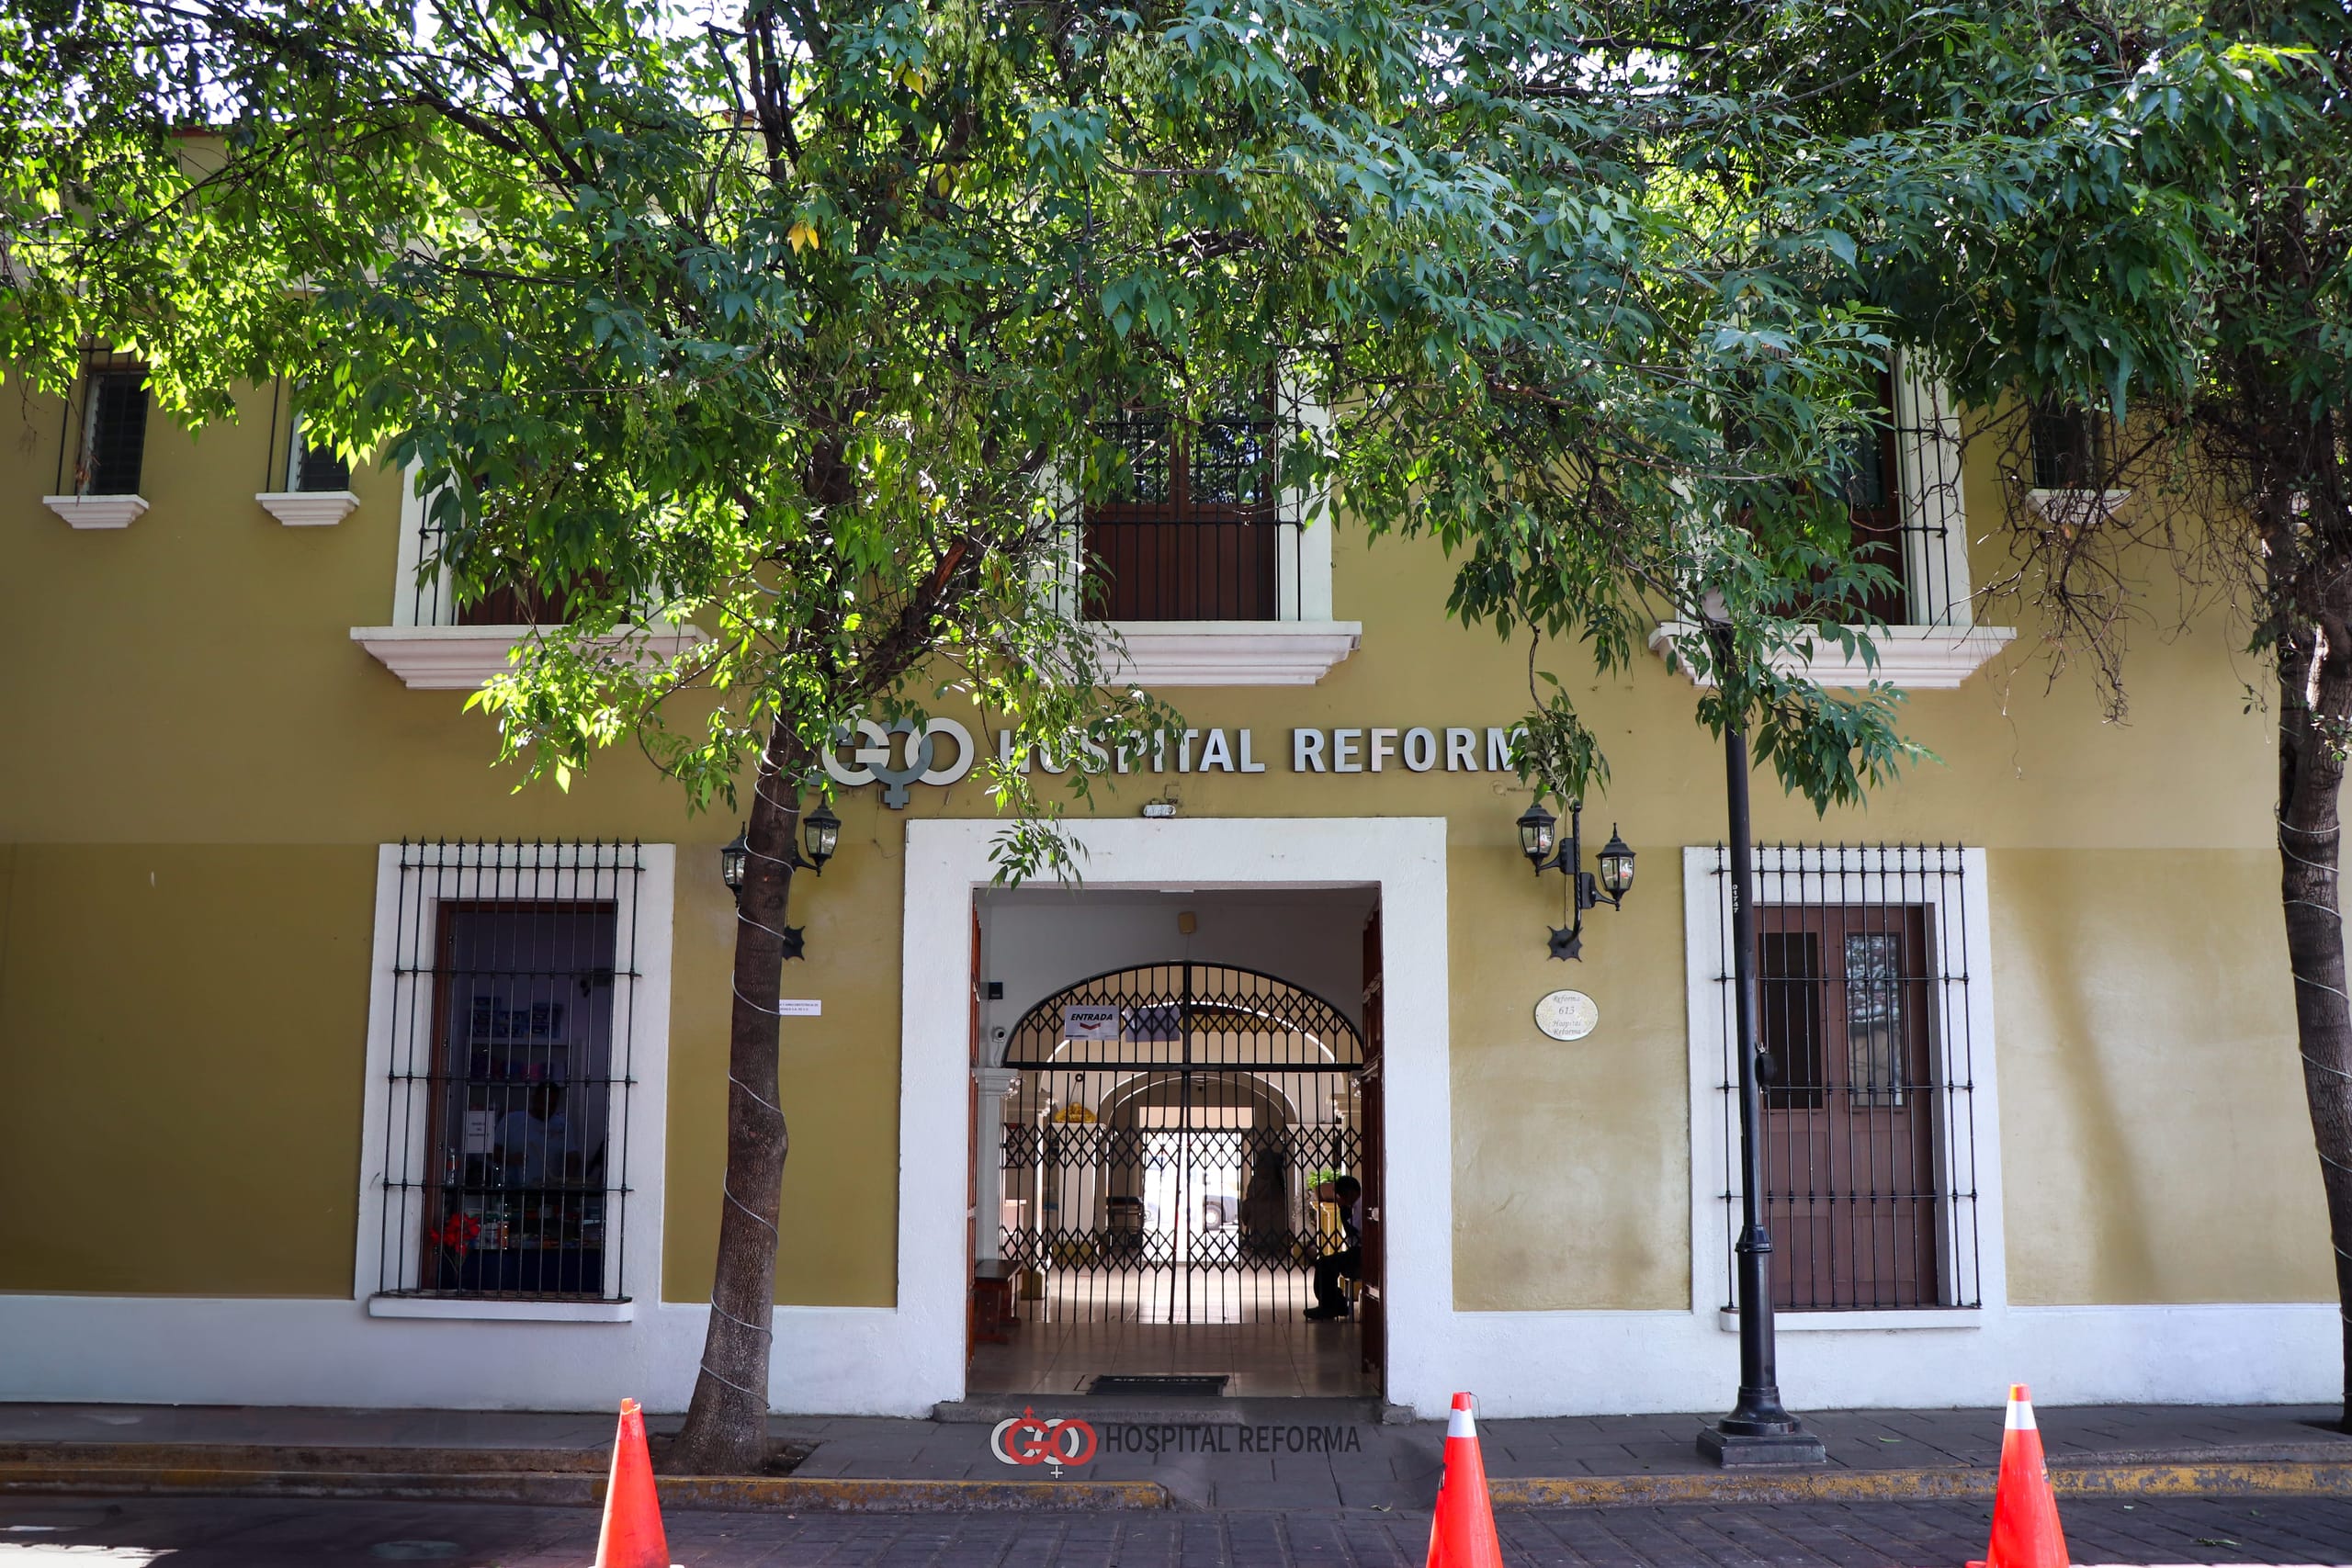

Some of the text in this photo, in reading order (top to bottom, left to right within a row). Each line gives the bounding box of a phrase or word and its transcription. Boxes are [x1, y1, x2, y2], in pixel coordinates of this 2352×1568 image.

[1294, 727, 1529, 773] REFORM
[1070, 1013, 1114, 1021] ENTRADA
[1552, 1020, 1581, 1029] Hospital
[1553, 1028, 1581, 1036] Reforma
